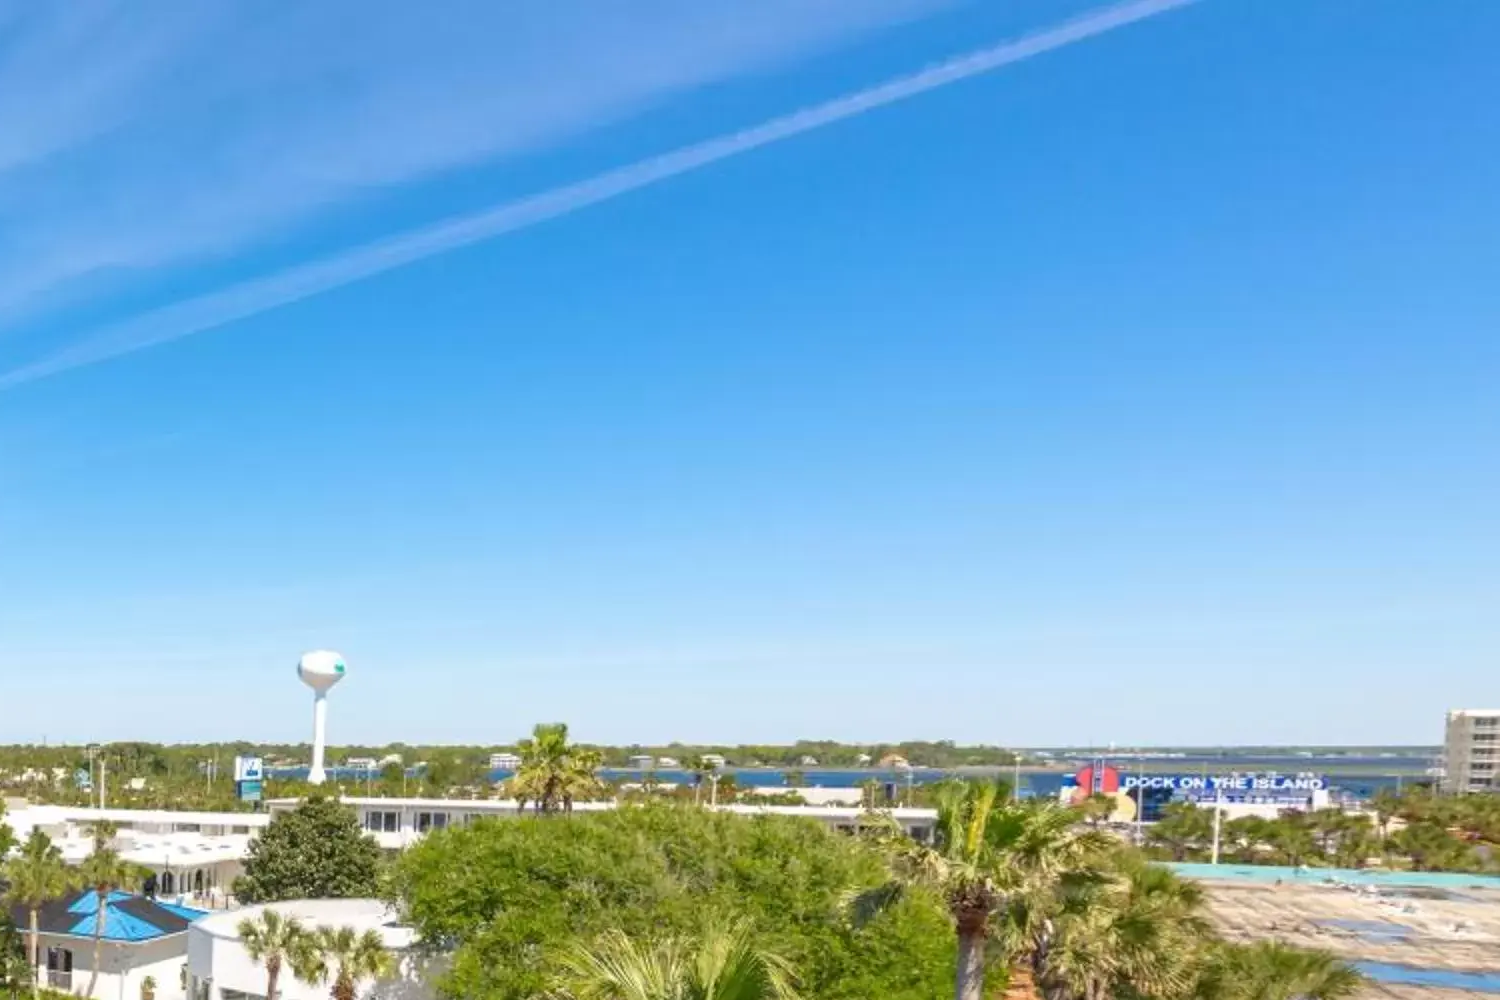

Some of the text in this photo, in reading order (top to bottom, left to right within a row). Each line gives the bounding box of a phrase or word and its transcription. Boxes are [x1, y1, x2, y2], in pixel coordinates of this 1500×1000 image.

[1125, 776, 1323, 790] DOCK ON THE ISLAND
